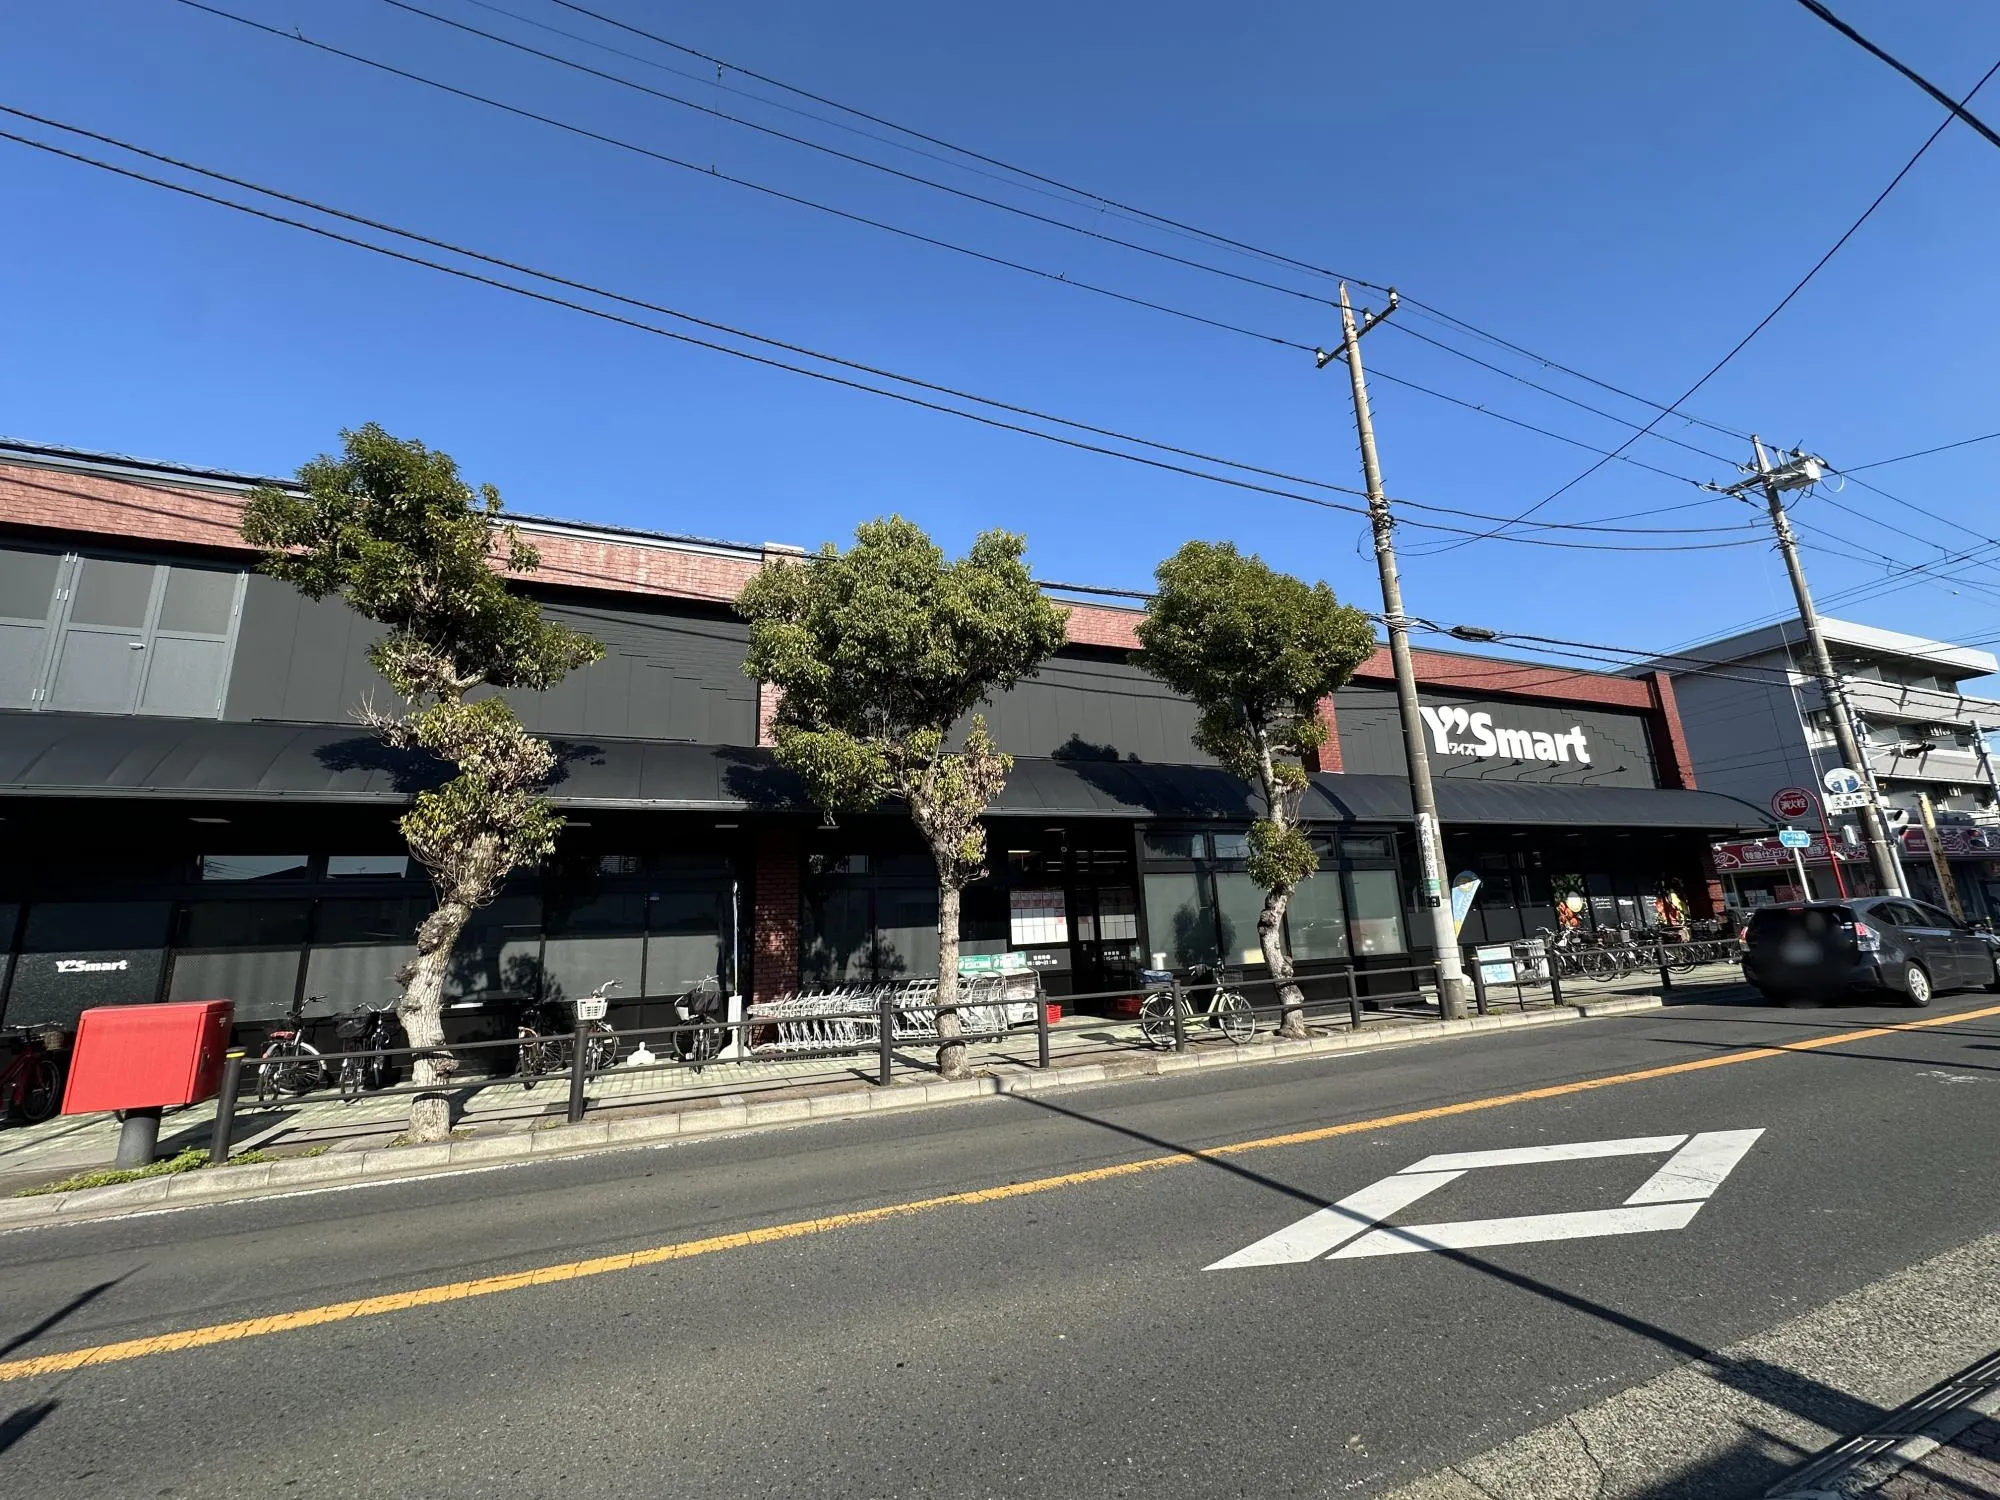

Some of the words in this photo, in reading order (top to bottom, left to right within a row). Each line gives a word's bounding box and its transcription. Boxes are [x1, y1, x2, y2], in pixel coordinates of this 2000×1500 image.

[1449, 743, 1475, 755] ワイズ
[1780, 798, 1807, 810] 消火栓
